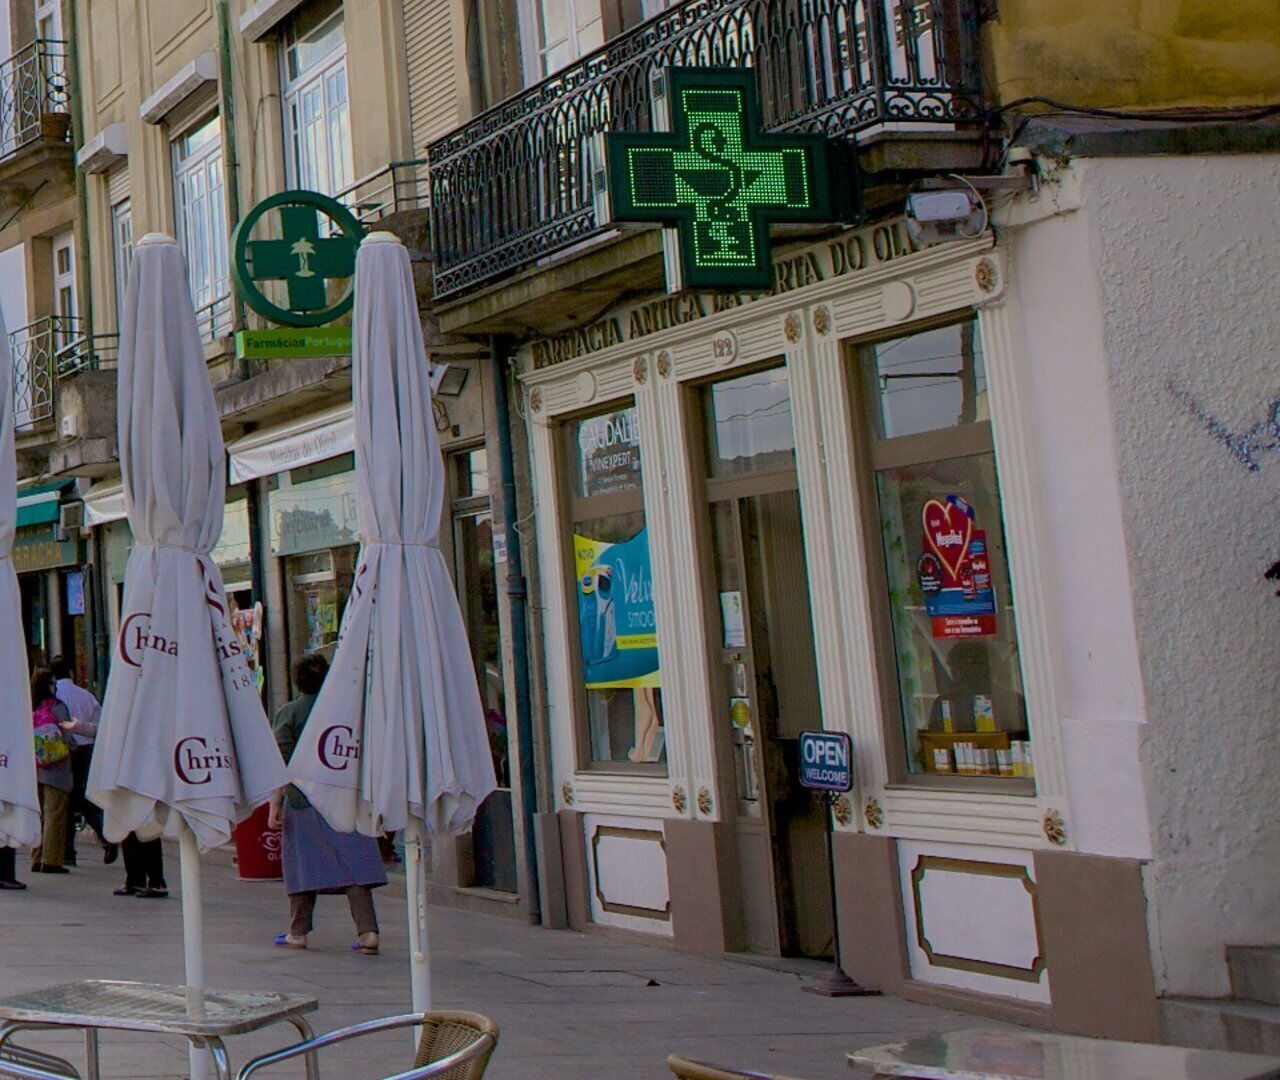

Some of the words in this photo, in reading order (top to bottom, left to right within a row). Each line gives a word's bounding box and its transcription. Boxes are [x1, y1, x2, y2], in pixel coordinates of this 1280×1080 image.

[829, 236, 865, 278] DO
[247, 337, 304, 349] Farmácias
[305, 336, 352, 349] Portugu
[712, 337, 733, 359] 122
[803, 738, 847, 767] OPEN
[805, 768, 848, 783] WELCOME
